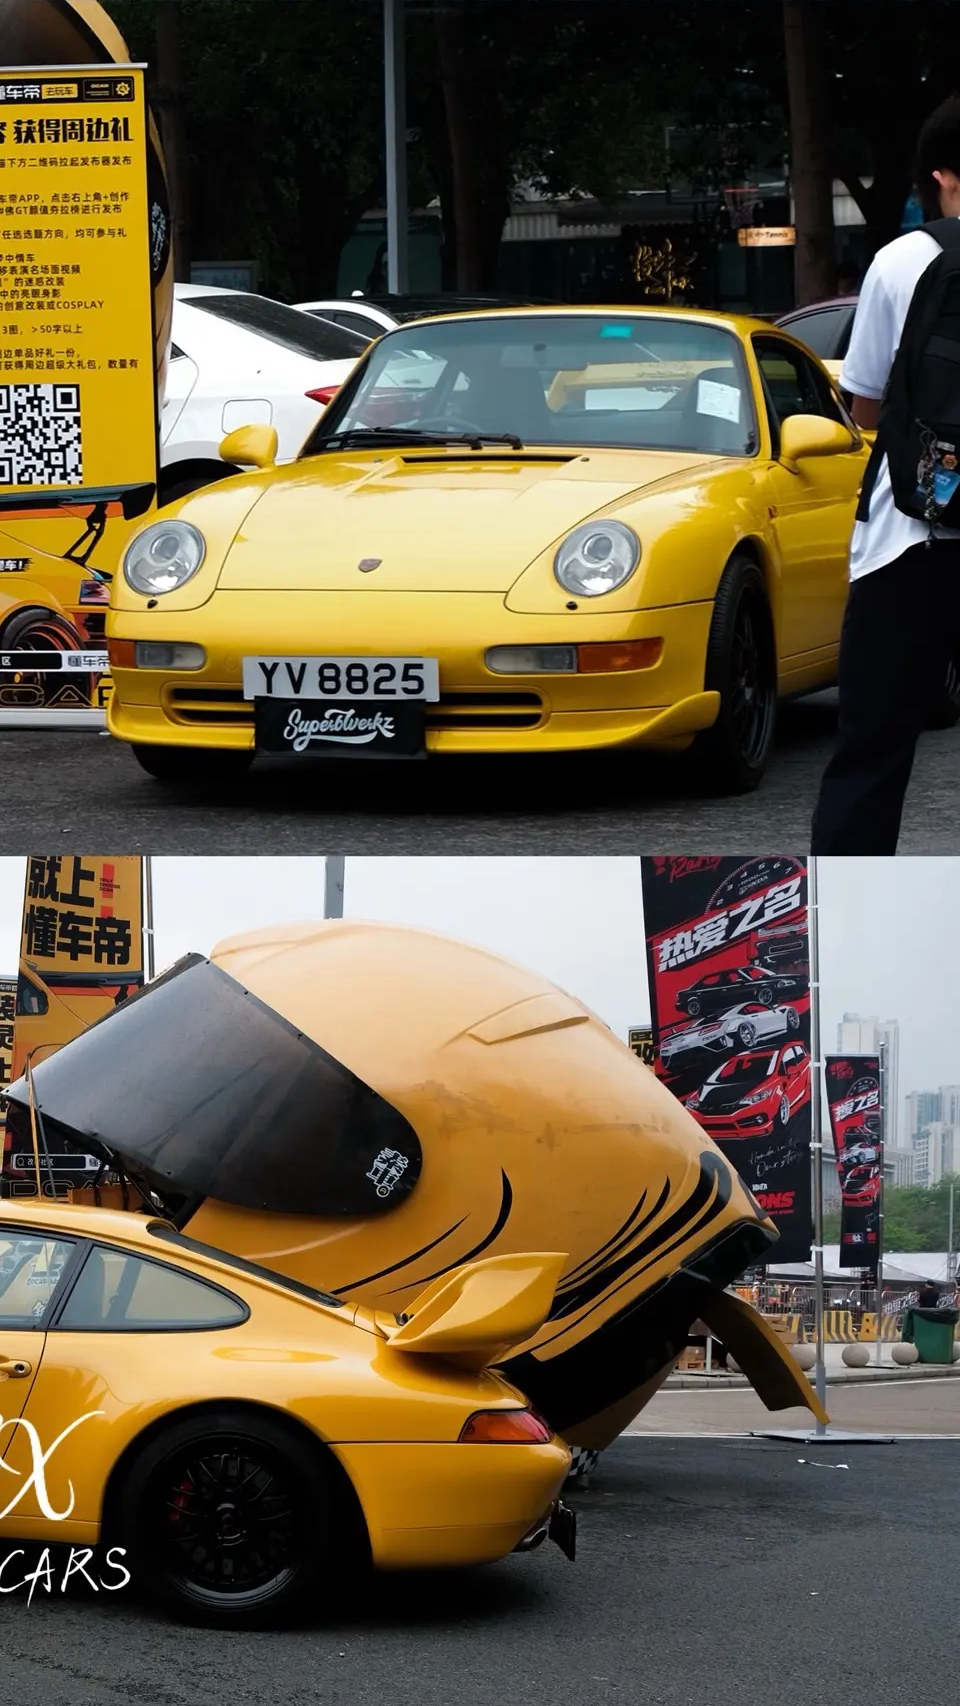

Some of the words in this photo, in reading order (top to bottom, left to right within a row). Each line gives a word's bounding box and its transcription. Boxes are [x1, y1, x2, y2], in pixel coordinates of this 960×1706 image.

[45, 86, 73, 97] 去玩车
[13, 117, 133, 143] 获得周边礼
[25, 904, 131, 965] 懂车帝
[658, 877, 801, 972] 热爱之名
